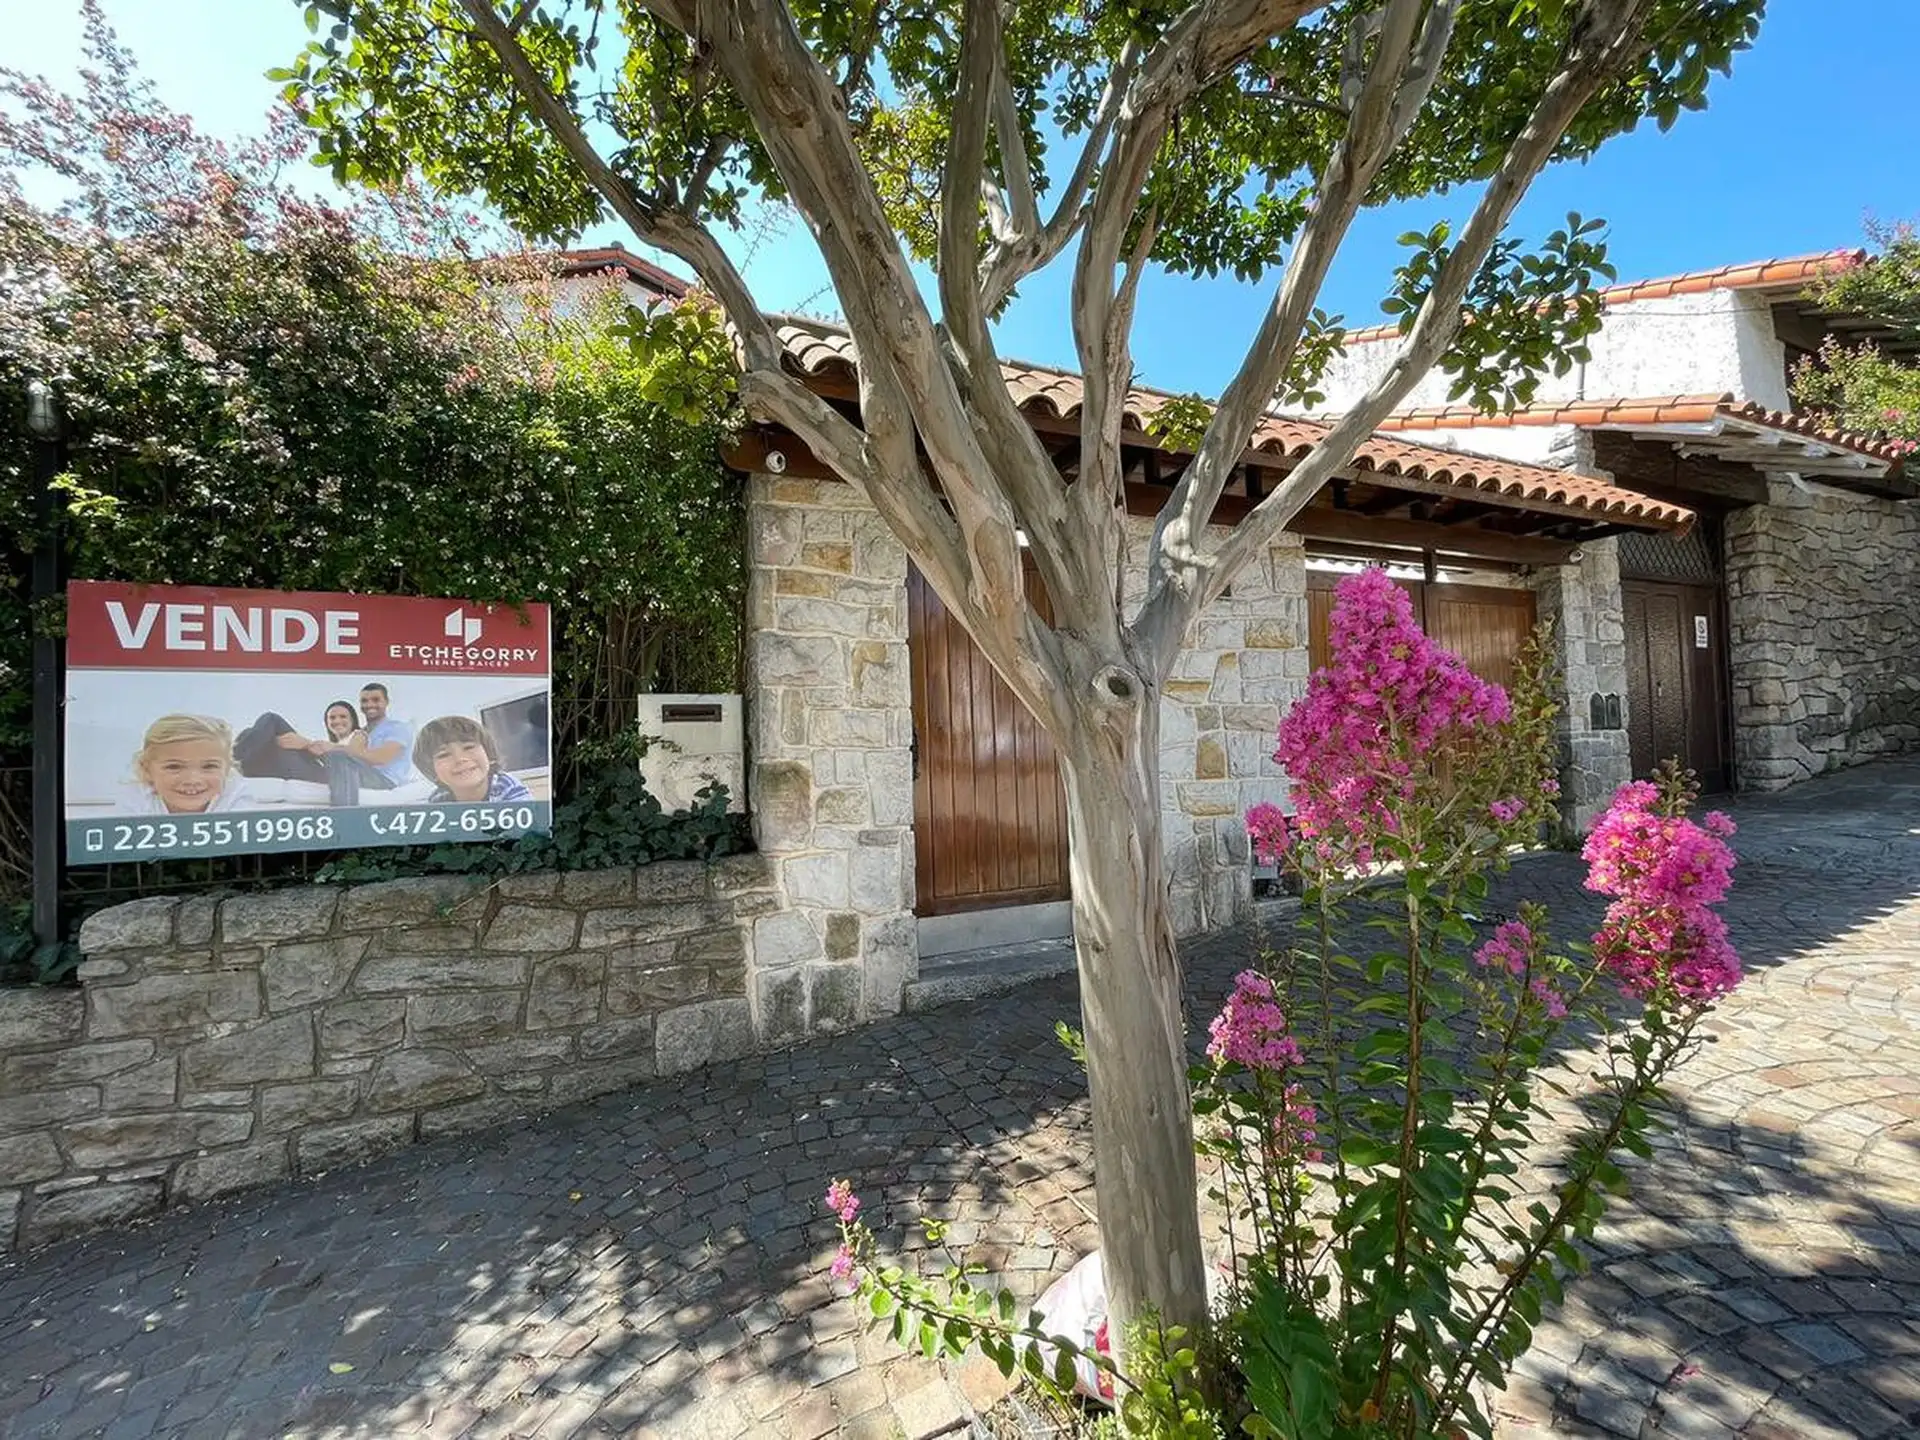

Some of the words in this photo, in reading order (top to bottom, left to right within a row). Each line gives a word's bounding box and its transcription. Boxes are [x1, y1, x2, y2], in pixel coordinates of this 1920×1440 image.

[105, 601, 361, 654] VENDE
[389, 645, 538, 661] ETCHEGORRY
[114, 816, 334, 851] 223.5519968
[389, 807, 533, 834] 472-6560
